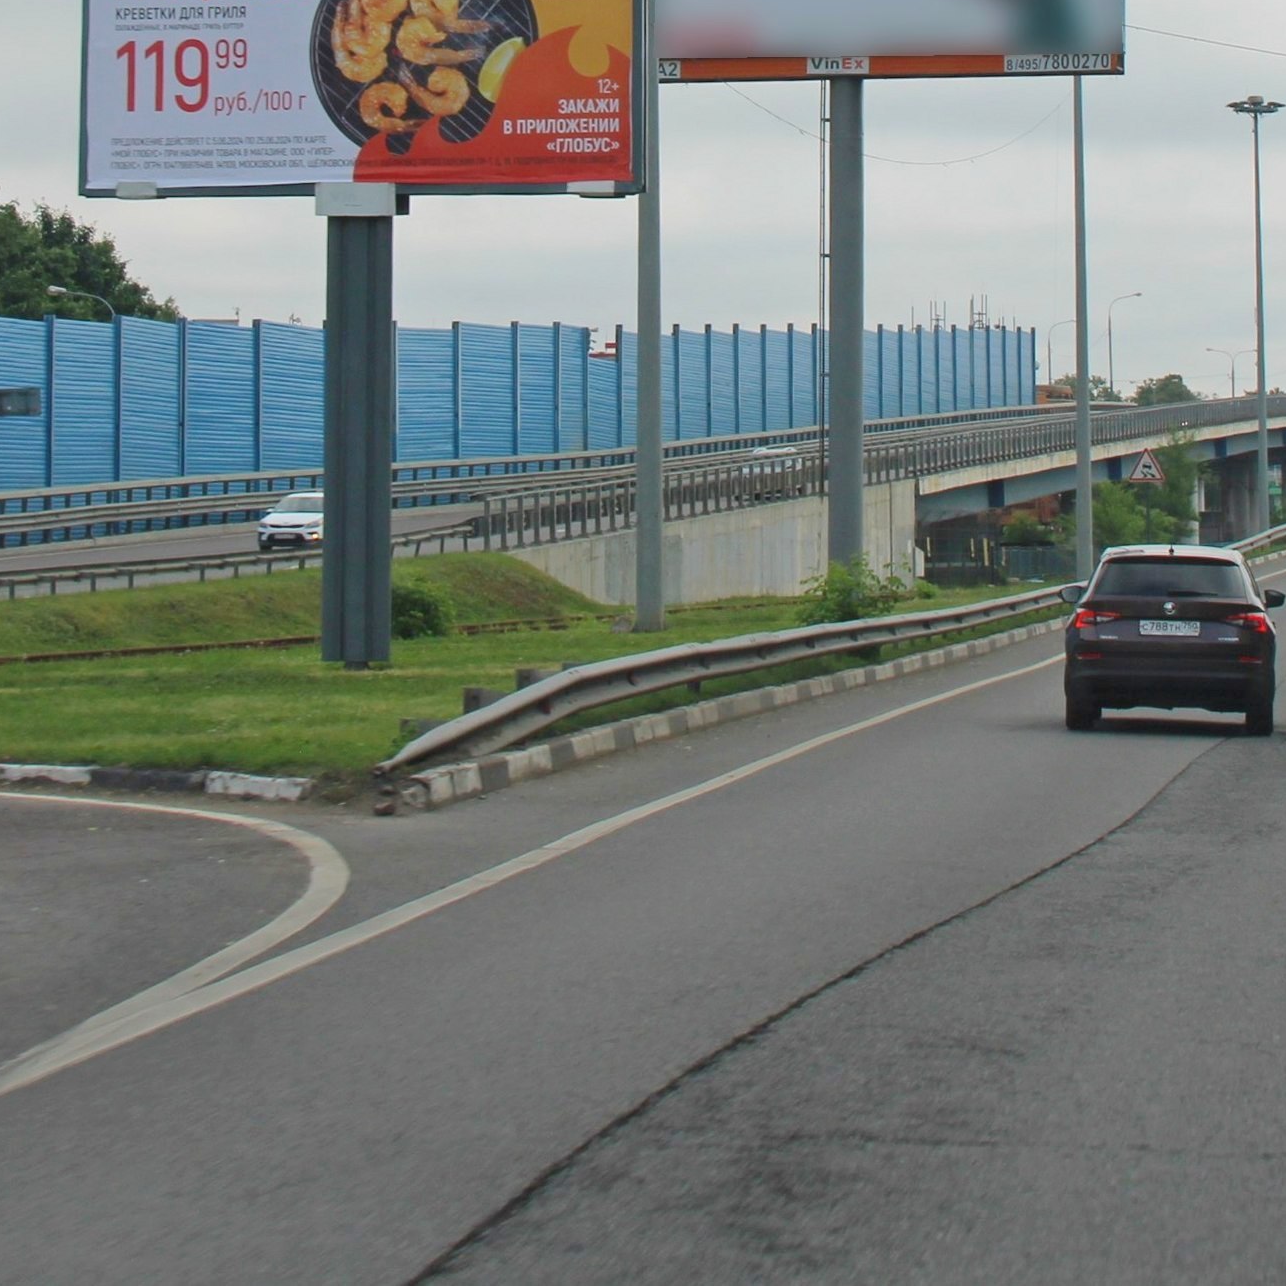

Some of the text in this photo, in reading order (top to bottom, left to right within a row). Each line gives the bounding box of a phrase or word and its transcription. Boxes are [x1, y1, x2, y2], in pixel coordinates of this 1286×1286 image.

[115, 6, 247, 20] КРЕВЕТКИ ДЛЯ ГРИЛЯ
[811, 57, 864, 69] VinEx
[116, 38, 247, 113] 119 99
[598, 78, 619, 94] 12+
[215, 89, 293, 115] руб./100
[558, 98, 619, 114] ЗАКАЖИ
[503, 117, 619, 134] В ПРИЛОЖЕНИИ
[546, 137, 620, 153] «ГЛОБУС»
